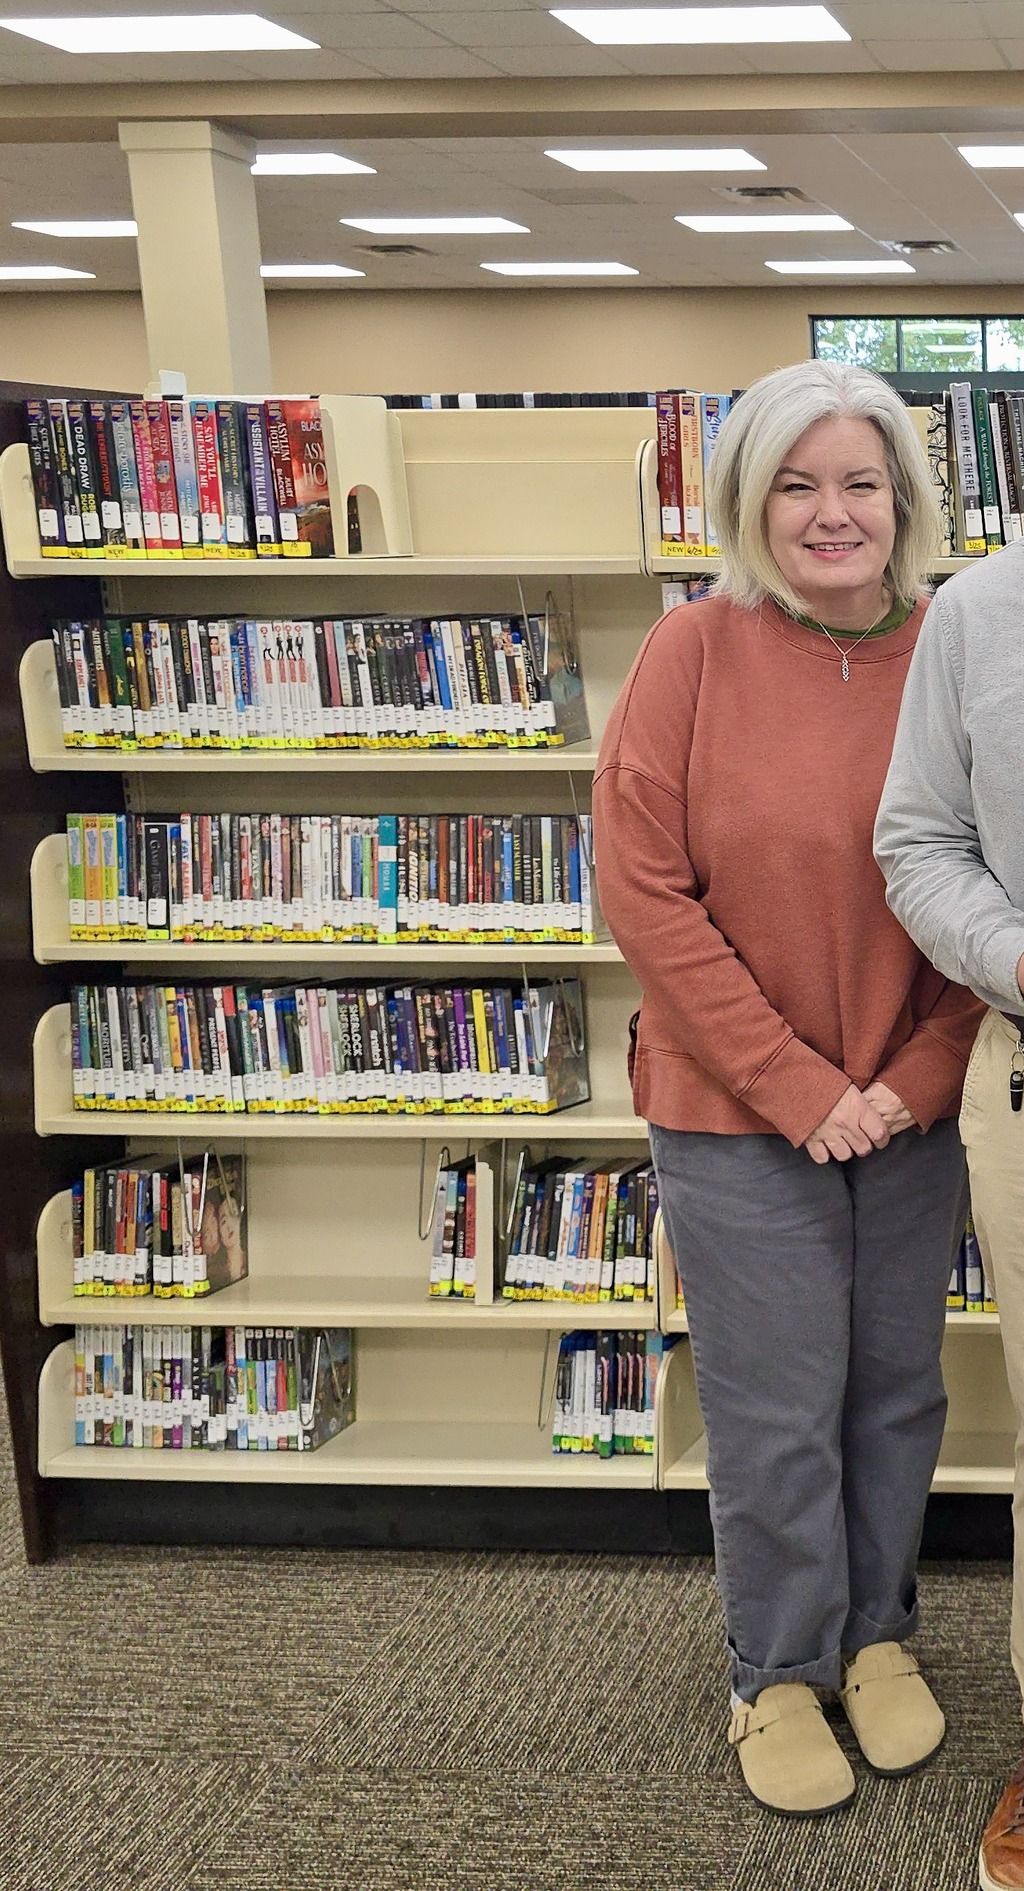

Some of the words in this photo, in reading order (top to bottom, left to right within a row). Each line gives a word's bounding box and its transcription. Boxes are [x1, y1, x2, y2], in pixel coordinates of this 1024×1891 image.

[957, 396, 968, 421] LOOK
[204, 426, 213, 444] SAY
[658, 419, 669, 457] HERCULES
[665, 414, 676, 440] BLOOD
[960, 424, 971, 440] FOR
[998, 404, 1009, 445] PROTECTION
[74, 427, 86, 455] DEAD
[157, 424, 169, 456] AUSTEN
[269, 425, 280, 457] HOTEL
[277, 422, 290, 461] ASYLUM
[669, 443, 676, 451] OF
[962, 446, 972, 458] ME
[78, 457, 90, 489] DRAW
[206, 448, 216, 480] YOU'LL
[963, 462, 975, 491] THERE
[1003, 451, 1013, 483] REVERSAL
[199, 474, 208, 488] ME
[255, 476, 267, 512] VILLAIN
[985, 480, 993, 504] FOREST
[1006, 484, 1016, 509] MAGICK
[409, 850, 418, 903] IGNITIO
[349, 1004, 362, 1057] SHERLOCK
